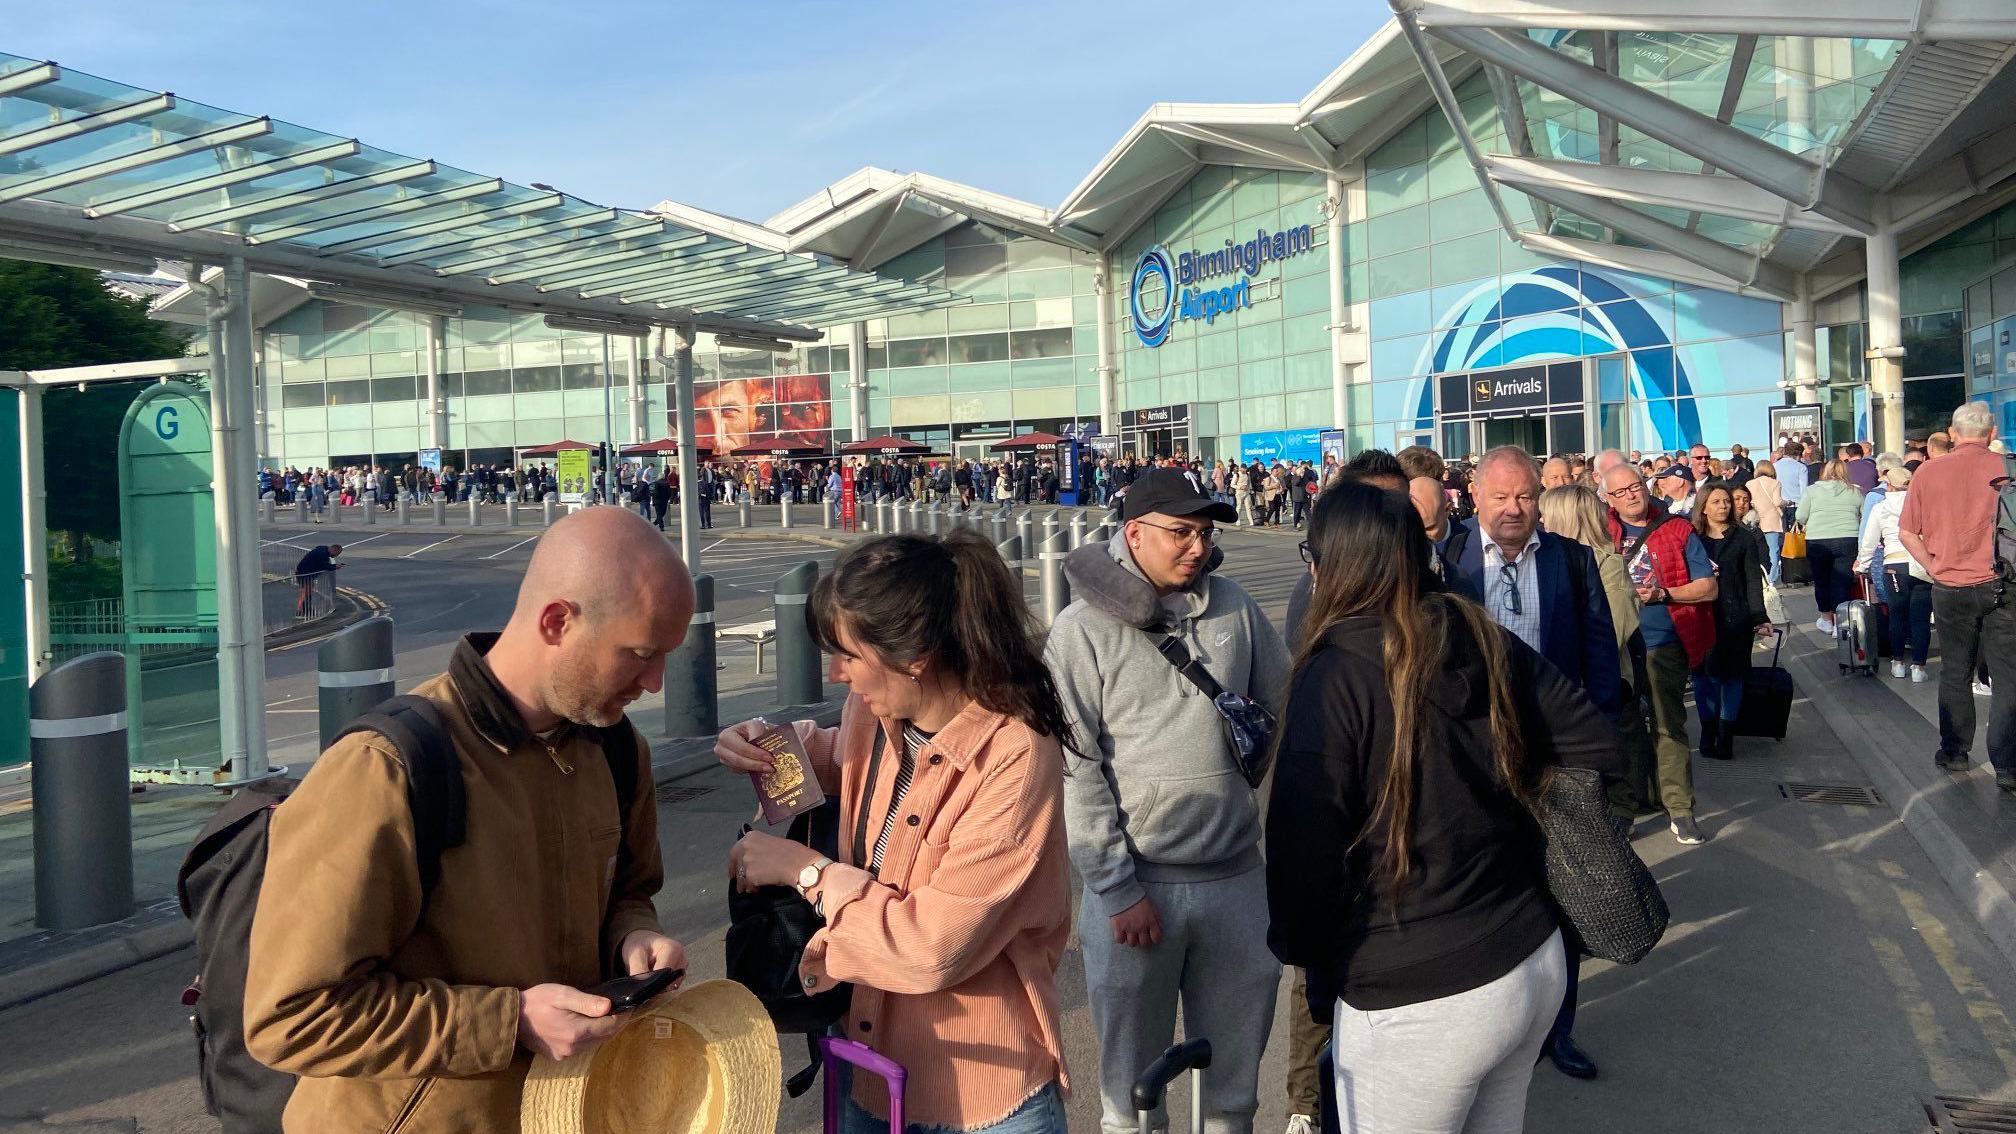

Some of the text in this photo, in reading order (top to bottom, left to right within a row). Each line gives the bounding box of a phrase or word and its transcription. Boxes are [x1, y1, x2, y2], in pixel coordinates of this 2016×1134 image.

[1178, 224, 1313, 285] Birmingham
[1180, 275, 1251, 325] Airport
[1494, 377, 1541, 397] Arrivals
[156, 406, 178, 440] G
[1147, 410, 1167, 420] Arrivals
[1780, 415, 1812, 429] NOTHING
[777, 789, 803, 805] PASSPORT
